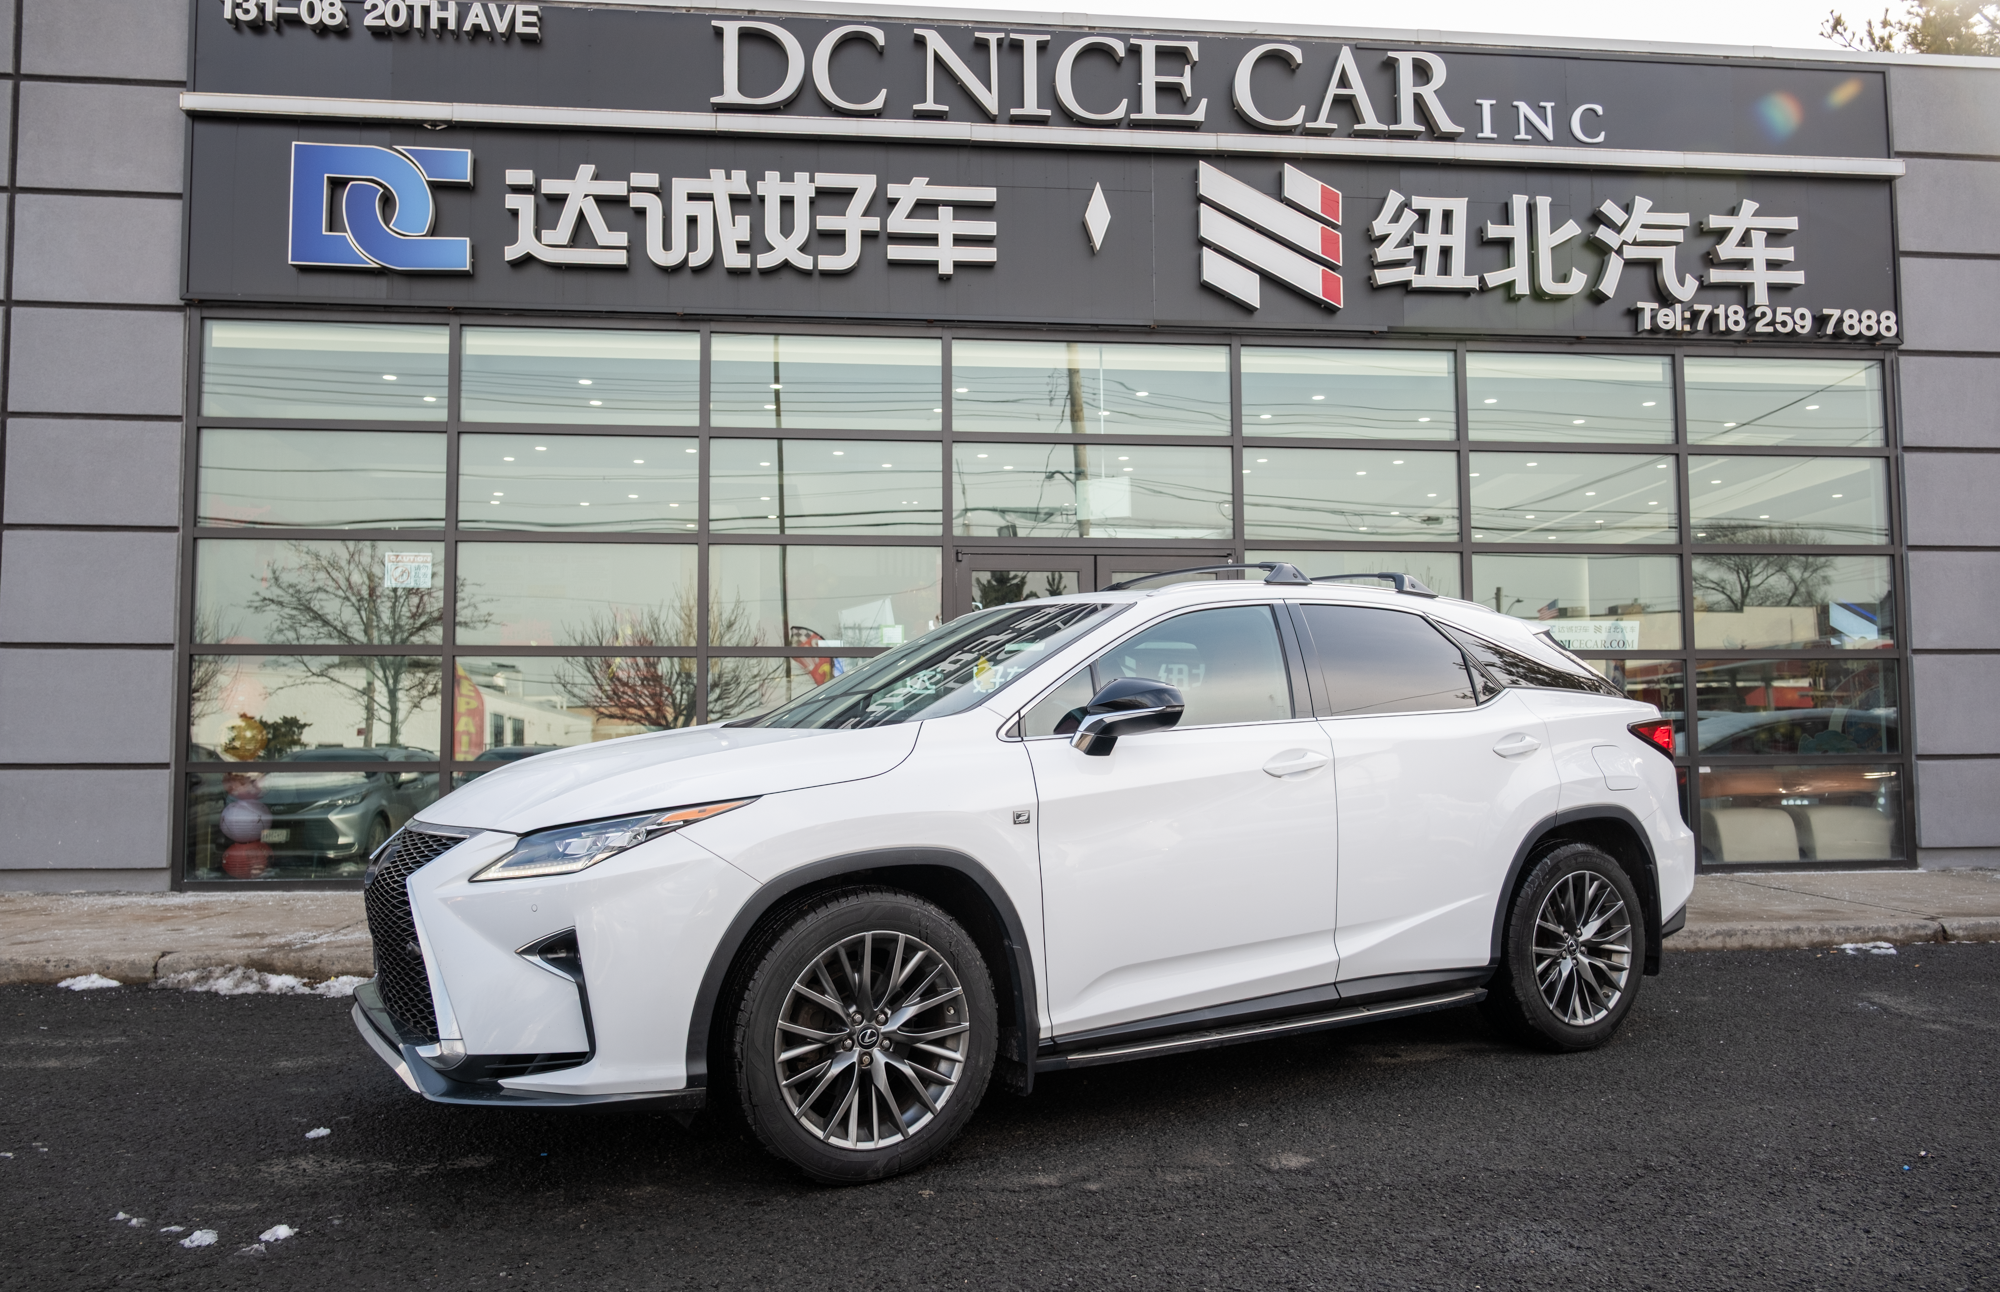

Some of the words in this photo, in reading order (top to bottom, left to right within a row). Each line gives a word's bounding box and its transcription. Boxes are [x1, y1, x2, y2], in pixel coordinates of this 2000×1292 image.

[363, 0, 459, 32] 20TH
[462, 2, 541, 39] AVE
[709, 20, 888, 115] DC
[913, 28, 1208, 128] NICE
[1232, 43, 1465, 137] CAR
[1475, 98, 1606, 144] INC
[504, 164, 998, 279] 达诚好车
[1369, 188, 1805, 305] 纽北汽车
[1753, 306, 1813, 334] 259
[1820, 308, 1898, 338] 7888
